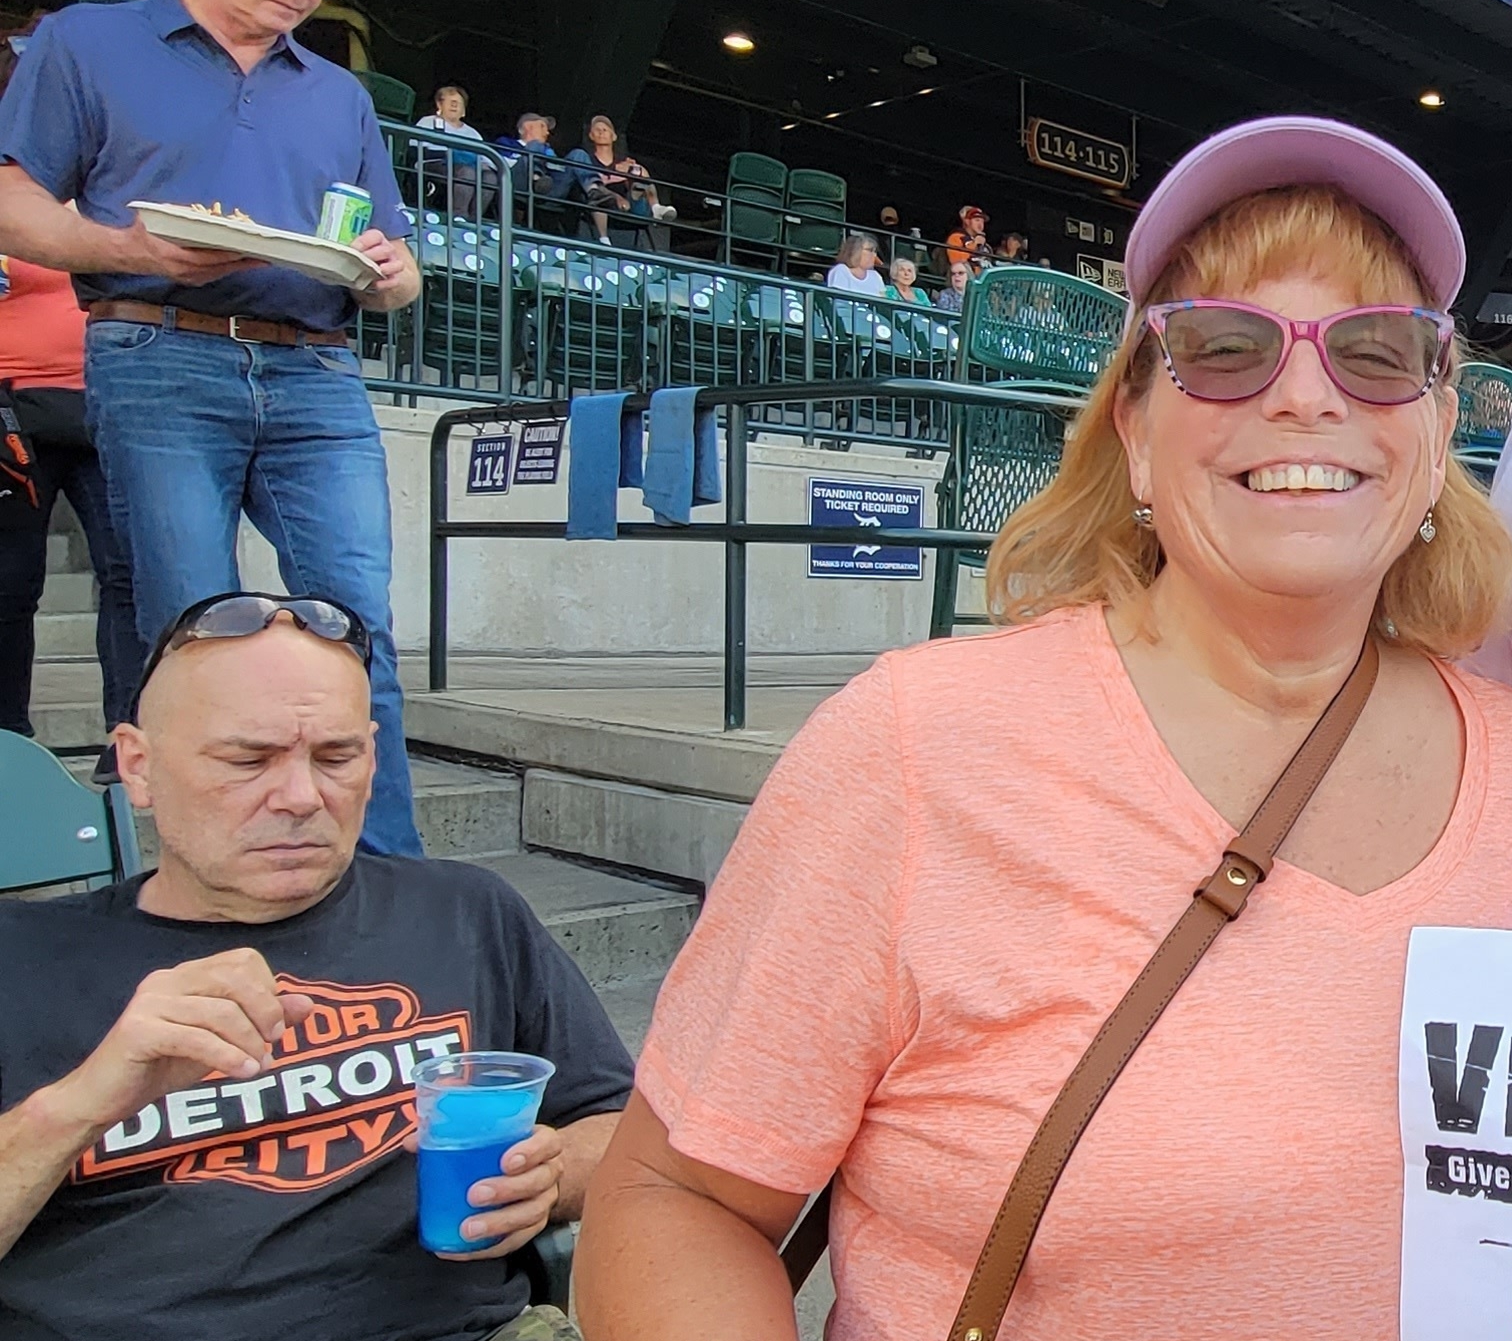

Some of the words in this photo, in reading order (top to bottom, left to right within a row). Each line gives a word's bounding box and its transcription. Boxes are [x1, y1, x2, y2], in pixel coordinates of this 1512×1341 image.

[475, 441, 506, 453] SECTION
[471, 455, 505, 488] 114
[813, 487, 863, 501] STANDING
[864, 491, 894, 503] ROOM
[895, 493, 920, 505] ONLY
[824, 499, 860, 511] TICKET
[861, 503, 909, 515] REQUIRED
[812, 560, 840, 568] THANKS
[840, 560, 855, 569] FOR
[104, 1032, 461, 1152] DETROIT
[205, 1111, 396, 1176] CITY
[1447, 1155, 1511, 1190] Give
